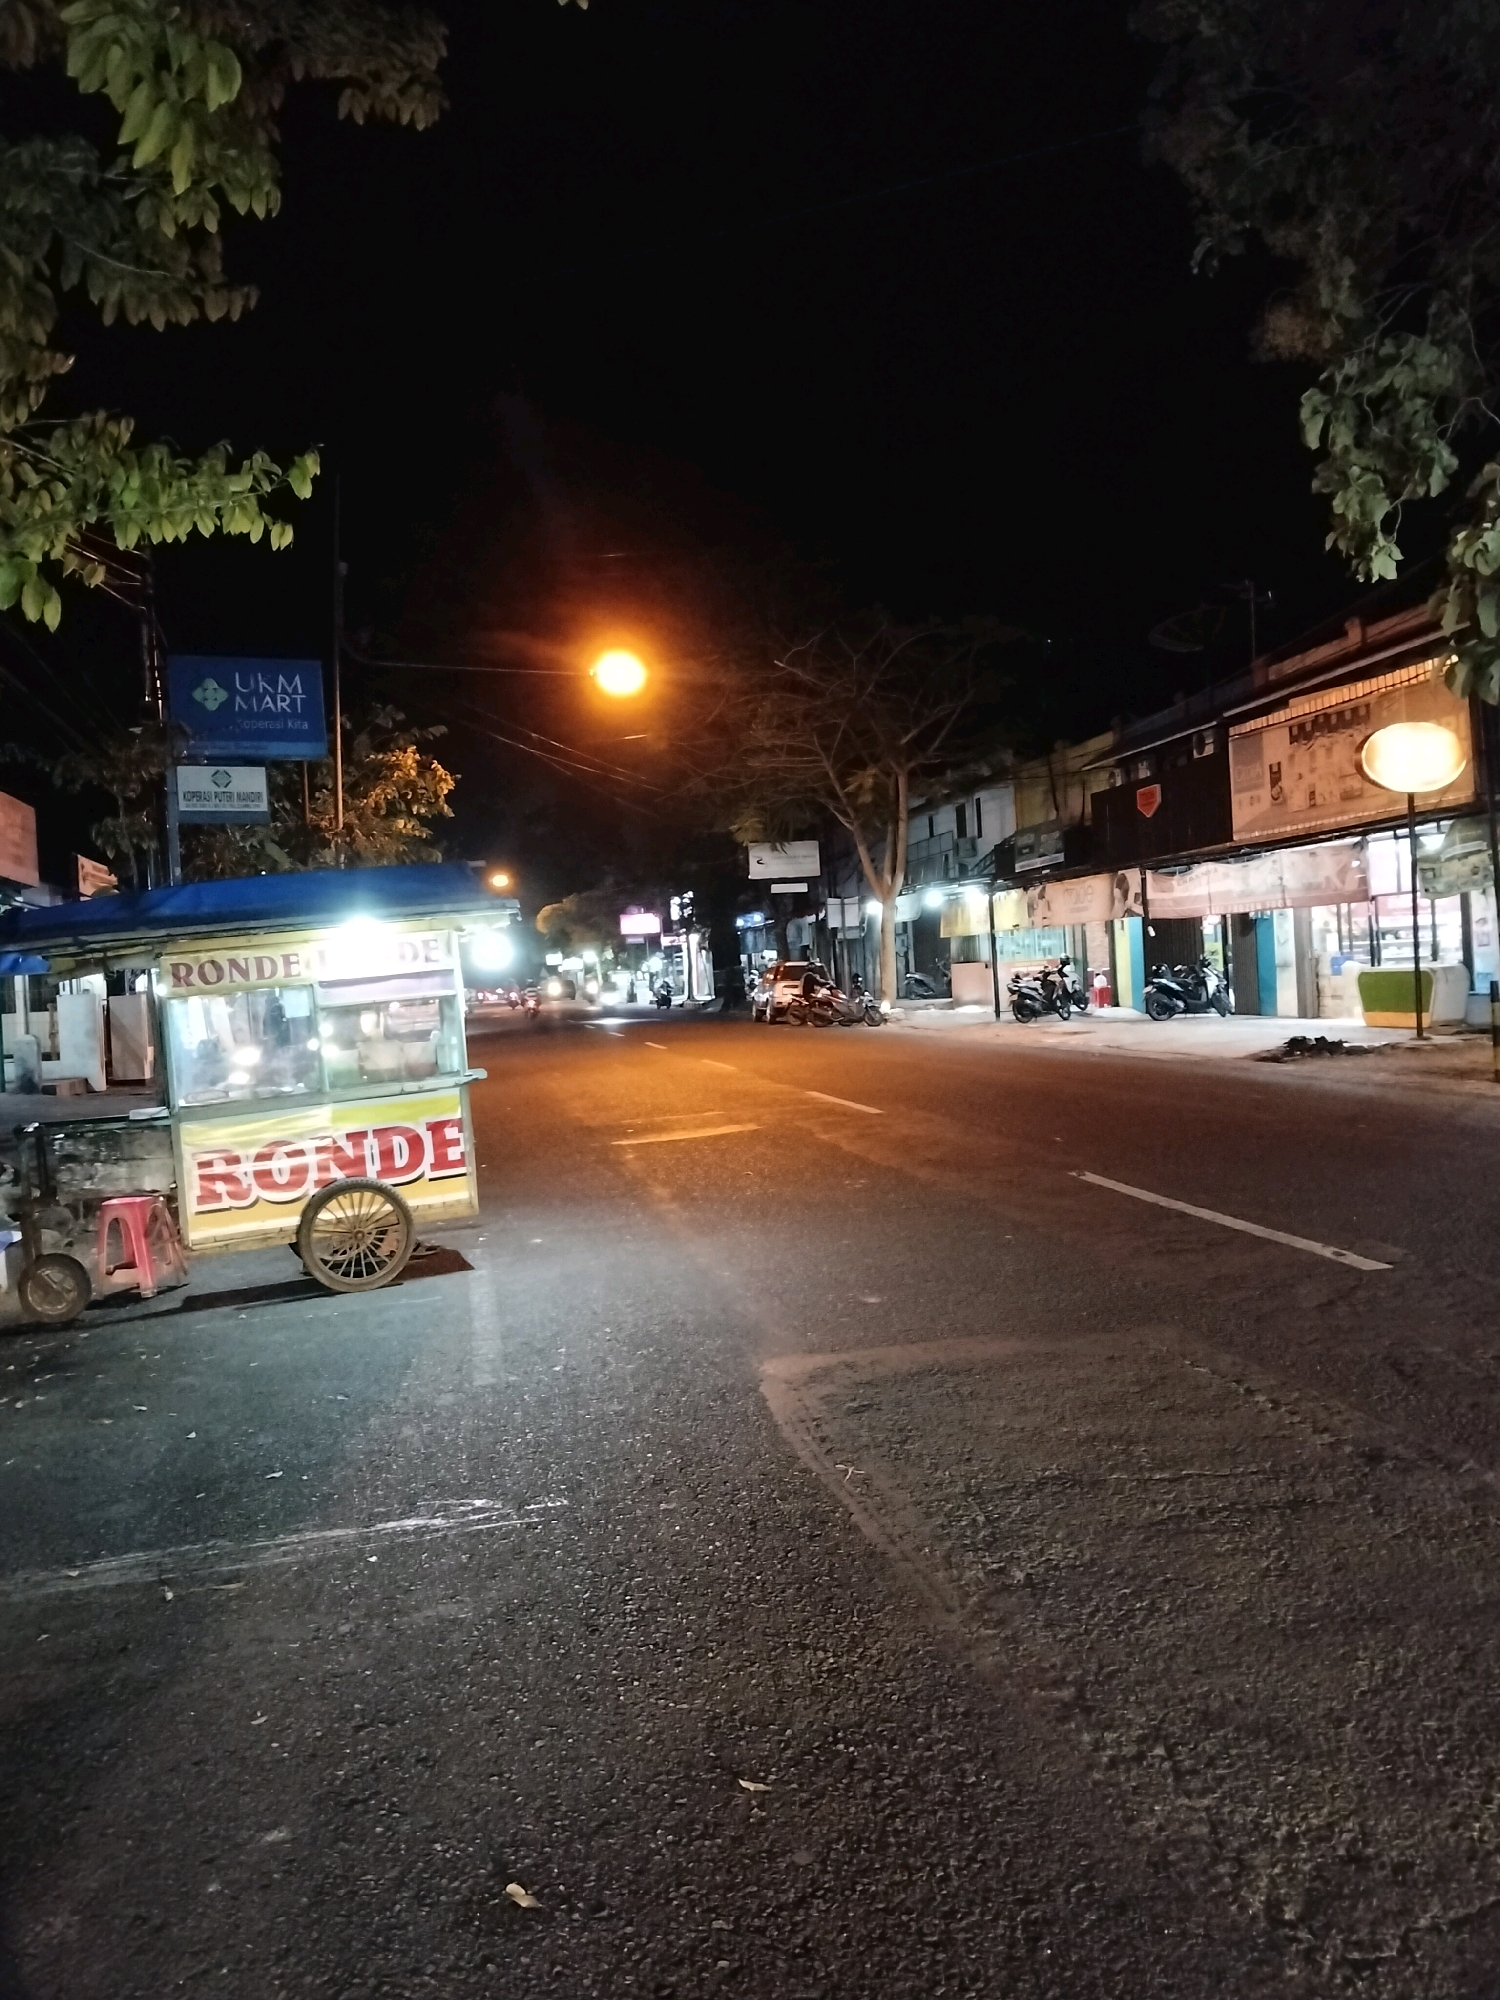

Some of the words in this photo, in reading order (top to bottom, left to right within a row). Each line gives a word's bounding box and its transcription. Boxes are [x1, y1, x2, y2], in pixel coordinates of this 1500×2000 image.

[235, 671, 303, 694] UKM
[235, 694, 307, 713] MART
[288, 718, 309, 730] Kita
[183, 790, 212, 802] KOPERASI
[213, 791, 235, 802] PUTERI
[236, 791, 264, 803] MANDIRI
[169, 952, 302, 989] RONDE
[192, 1117, 468, 1208] RONDE
